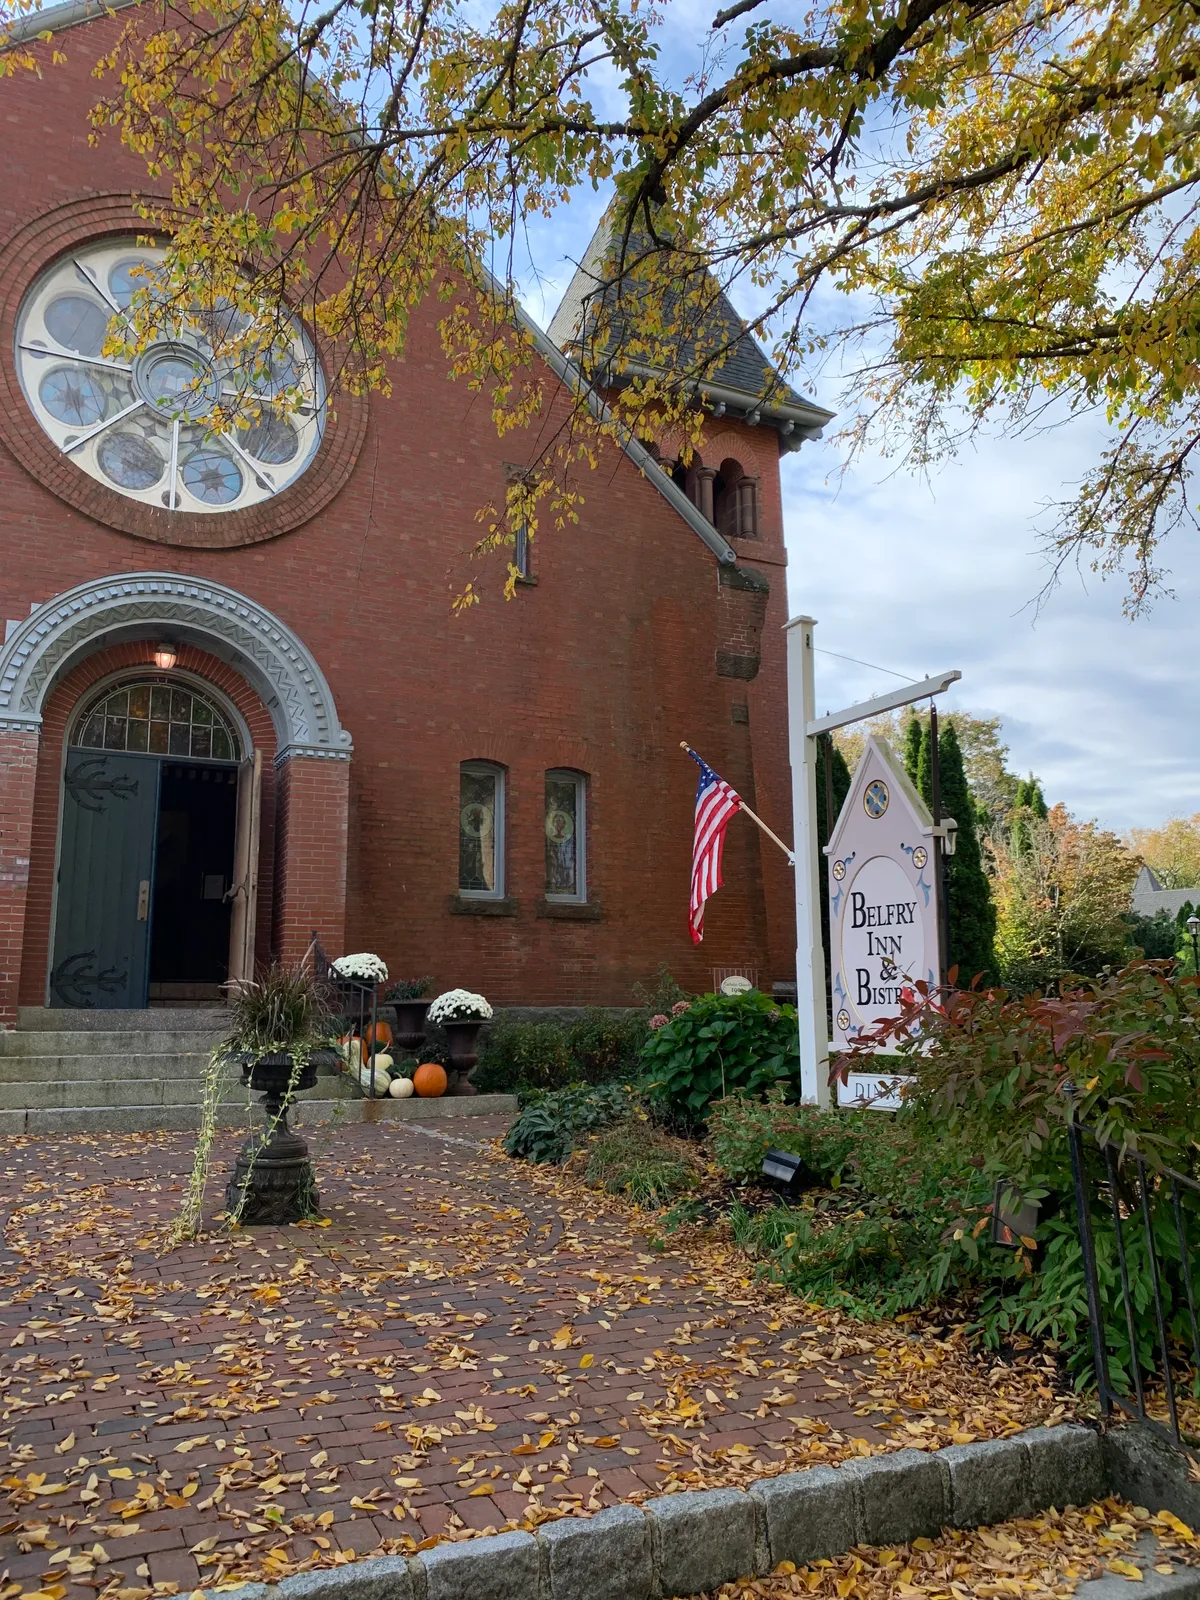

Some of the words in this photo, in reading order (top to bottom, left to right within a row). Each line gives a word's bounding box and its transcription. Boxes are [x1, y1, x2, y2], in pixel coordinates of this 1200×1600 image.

[851, 891, 917, 928] BELFRY
[867, 931, 902, 956] INN
[880, 959, 897, 981] &
[855, 968, 907, 1006] BISTR
